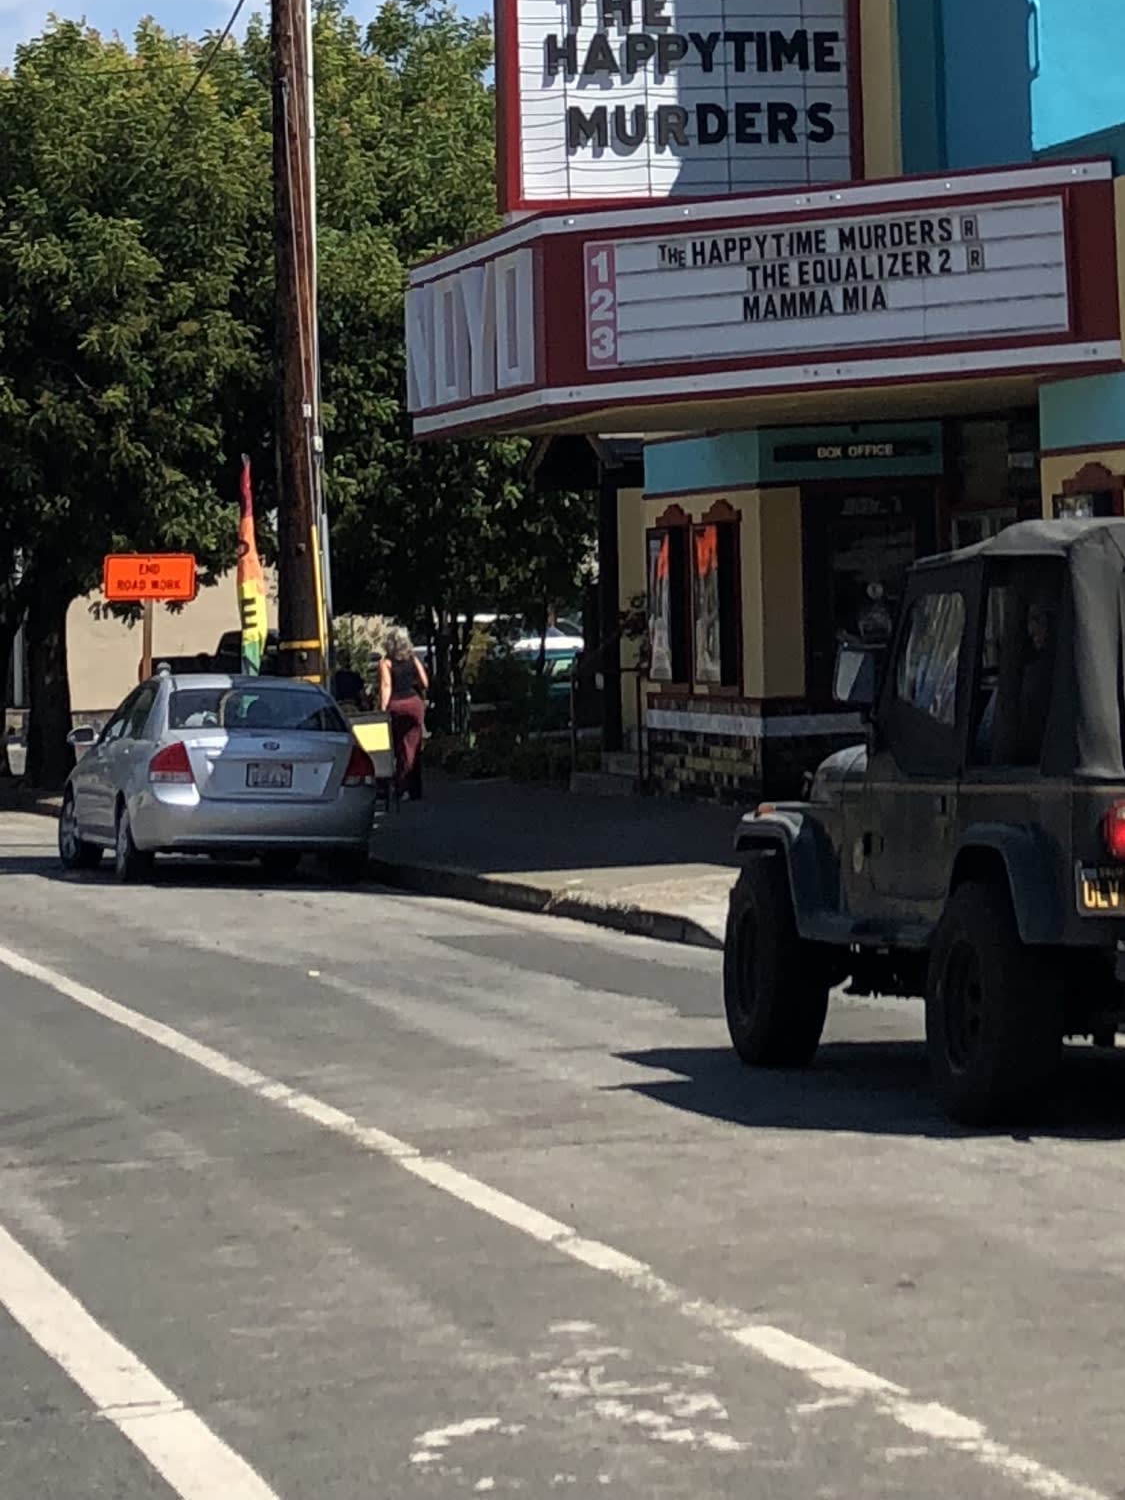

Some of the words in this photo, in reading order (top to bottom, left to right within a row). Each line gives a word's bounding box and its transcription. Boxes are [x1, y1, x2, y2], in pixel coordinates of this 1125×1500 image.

[546, 29, 842, 77] HAPPYTIME
[567, 101, 836, 150] MURDERS
[657, 244, 687, 267] THE
[691, 229, 827, 266] HAPPYTIME
[838, 217, 953, 251] MURDERS
[590, 251, 609, 283] 1
[746, 263, 790, 291] THE
[798, 250, 932, 286] EQUALIZER
[937, 248, 953, 274] 2
[590, 288, 615, 321] 2
[742, 290, 834, 322] MAMMA
[842, 284, 888, 312] MIA
[590, 326, 616, 359] 3
[817, 446, 842, 459] BOX
[848, 444, 894, 458] OFFICE
[116, 579, 147, 591] ROAD
[150, 579, 182, 592] WORK
[138, 563, 161, 576] END
